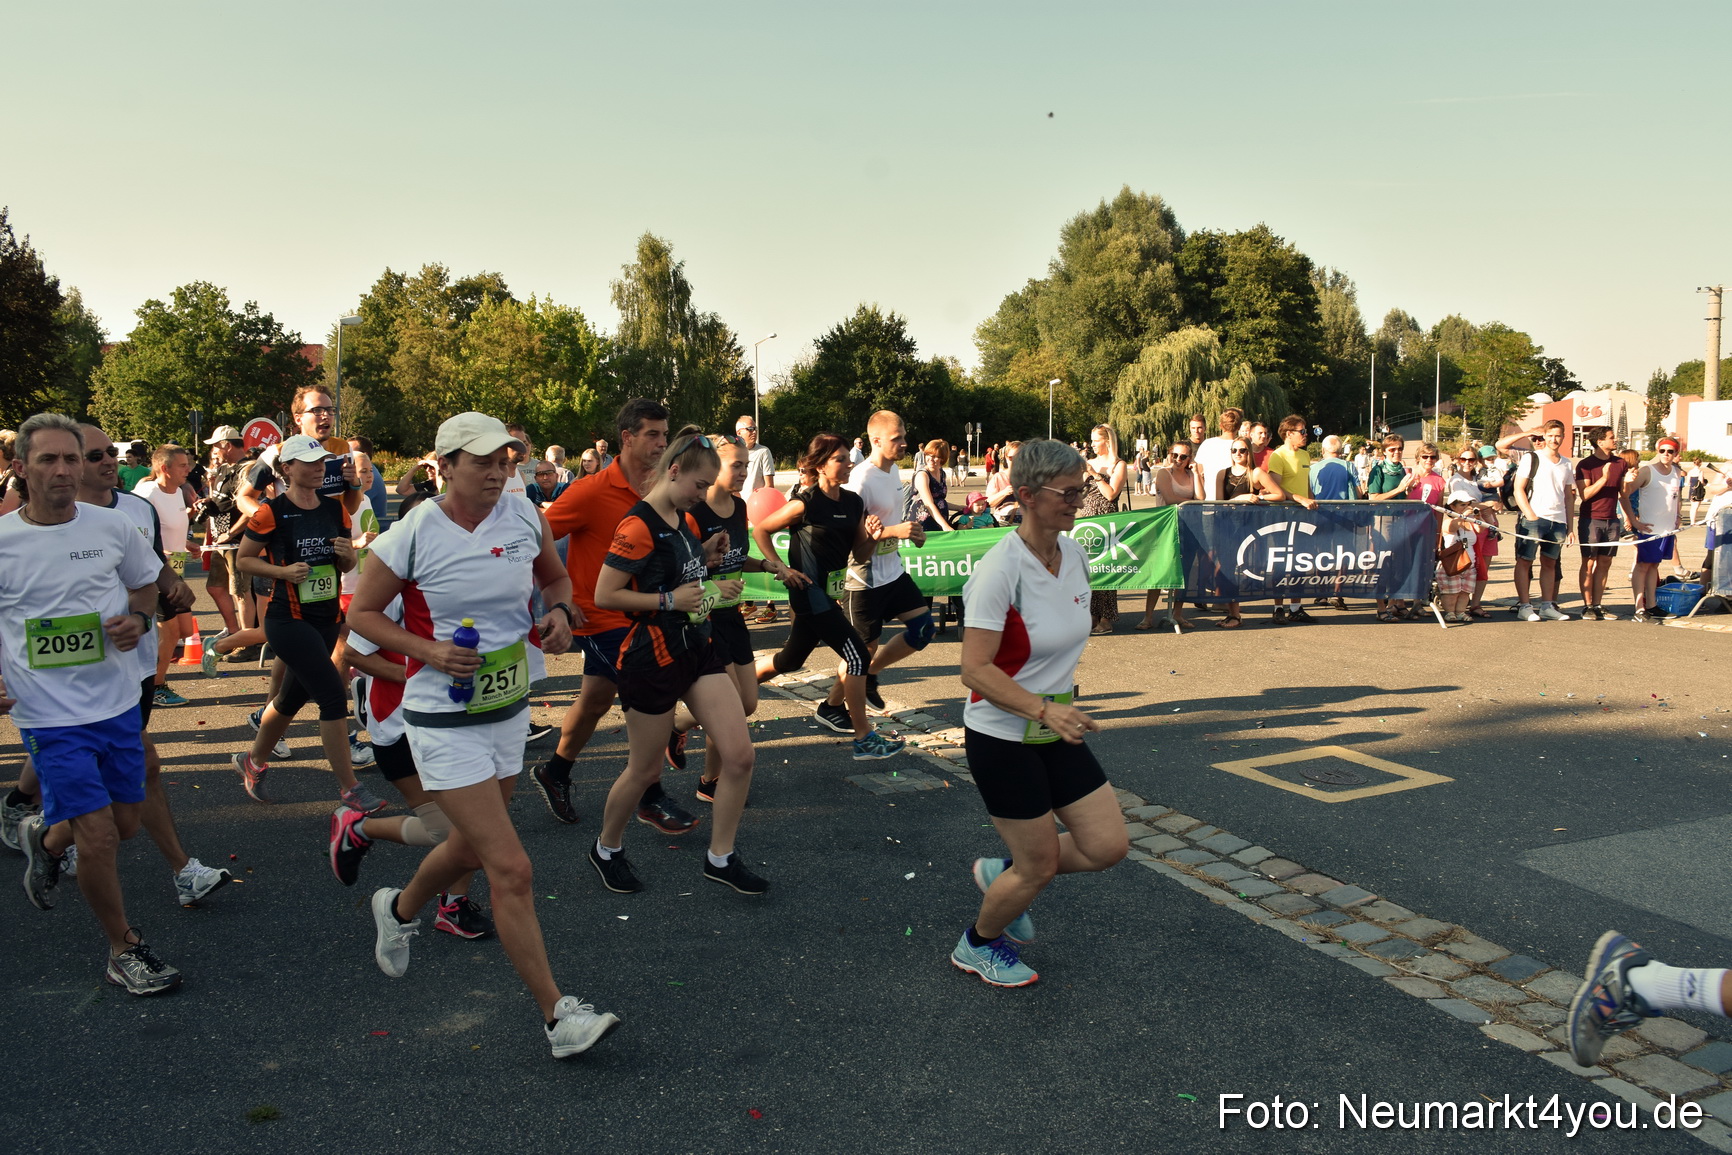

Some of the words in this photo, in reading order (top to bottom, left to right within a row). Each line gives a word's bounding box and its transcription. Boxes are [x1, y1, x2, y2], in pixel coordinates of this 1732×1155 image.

[296, 536, 326, 548] HECK
[1060, 521, 1139, 564] OK
[69, 549, 104, 561] ALBERT
[1265, 544, 1392, 573] Fischer
[308, 576, 332, 593] 799
[1276, 574, 1380, 588] AUTOMOBILE
[36, 631, 95, 655] 2092
[480, 663, 518, 696] 257
